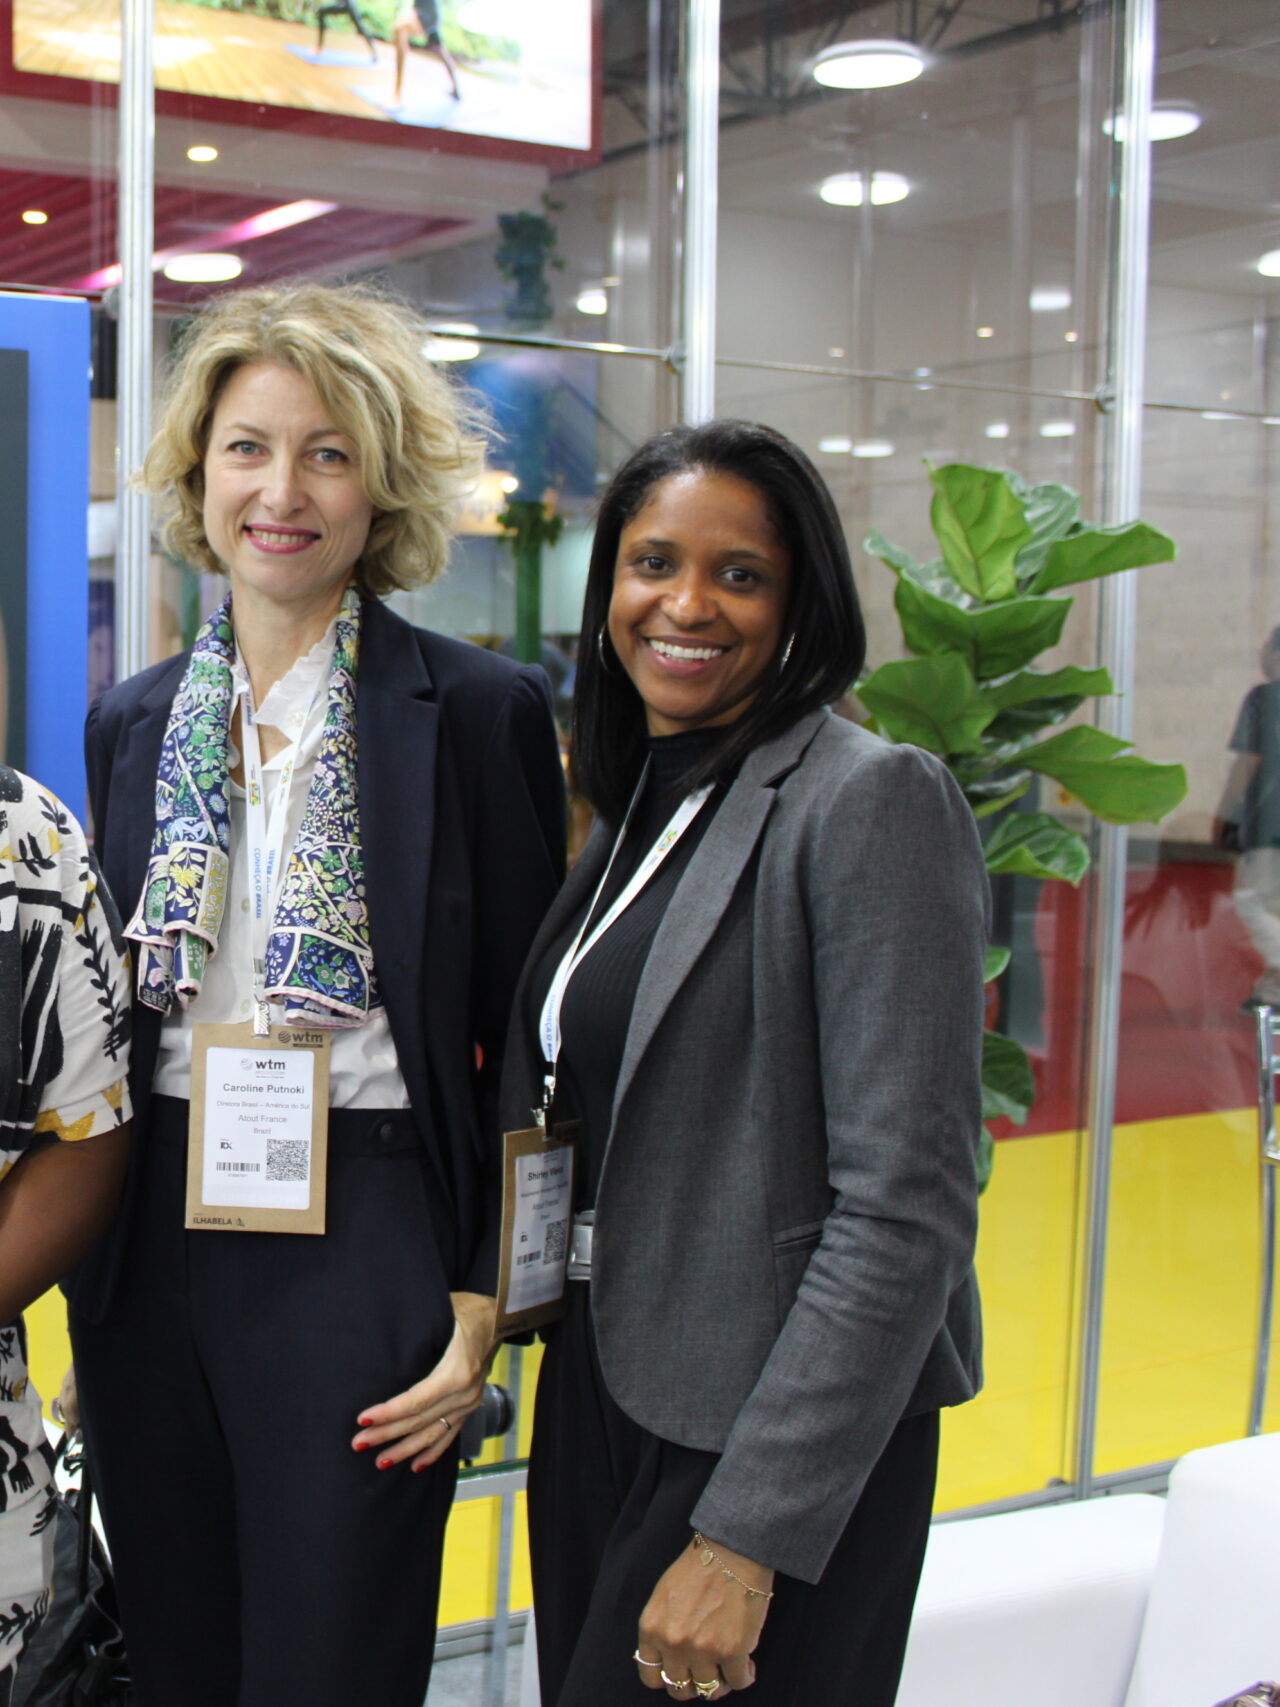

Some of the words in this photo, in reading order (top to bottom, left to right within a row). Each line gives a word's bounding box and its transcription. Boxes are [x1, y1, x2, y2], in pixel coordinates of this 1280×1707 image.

[293, 1032, 323, 1042] wtm
[256, 1059, 285, 1070] wtm
[223, 1083, 264, 1093] Caroline
[267, 1084, 304, 1094] Putnoki
[261, 1115, 287, 1123] France
